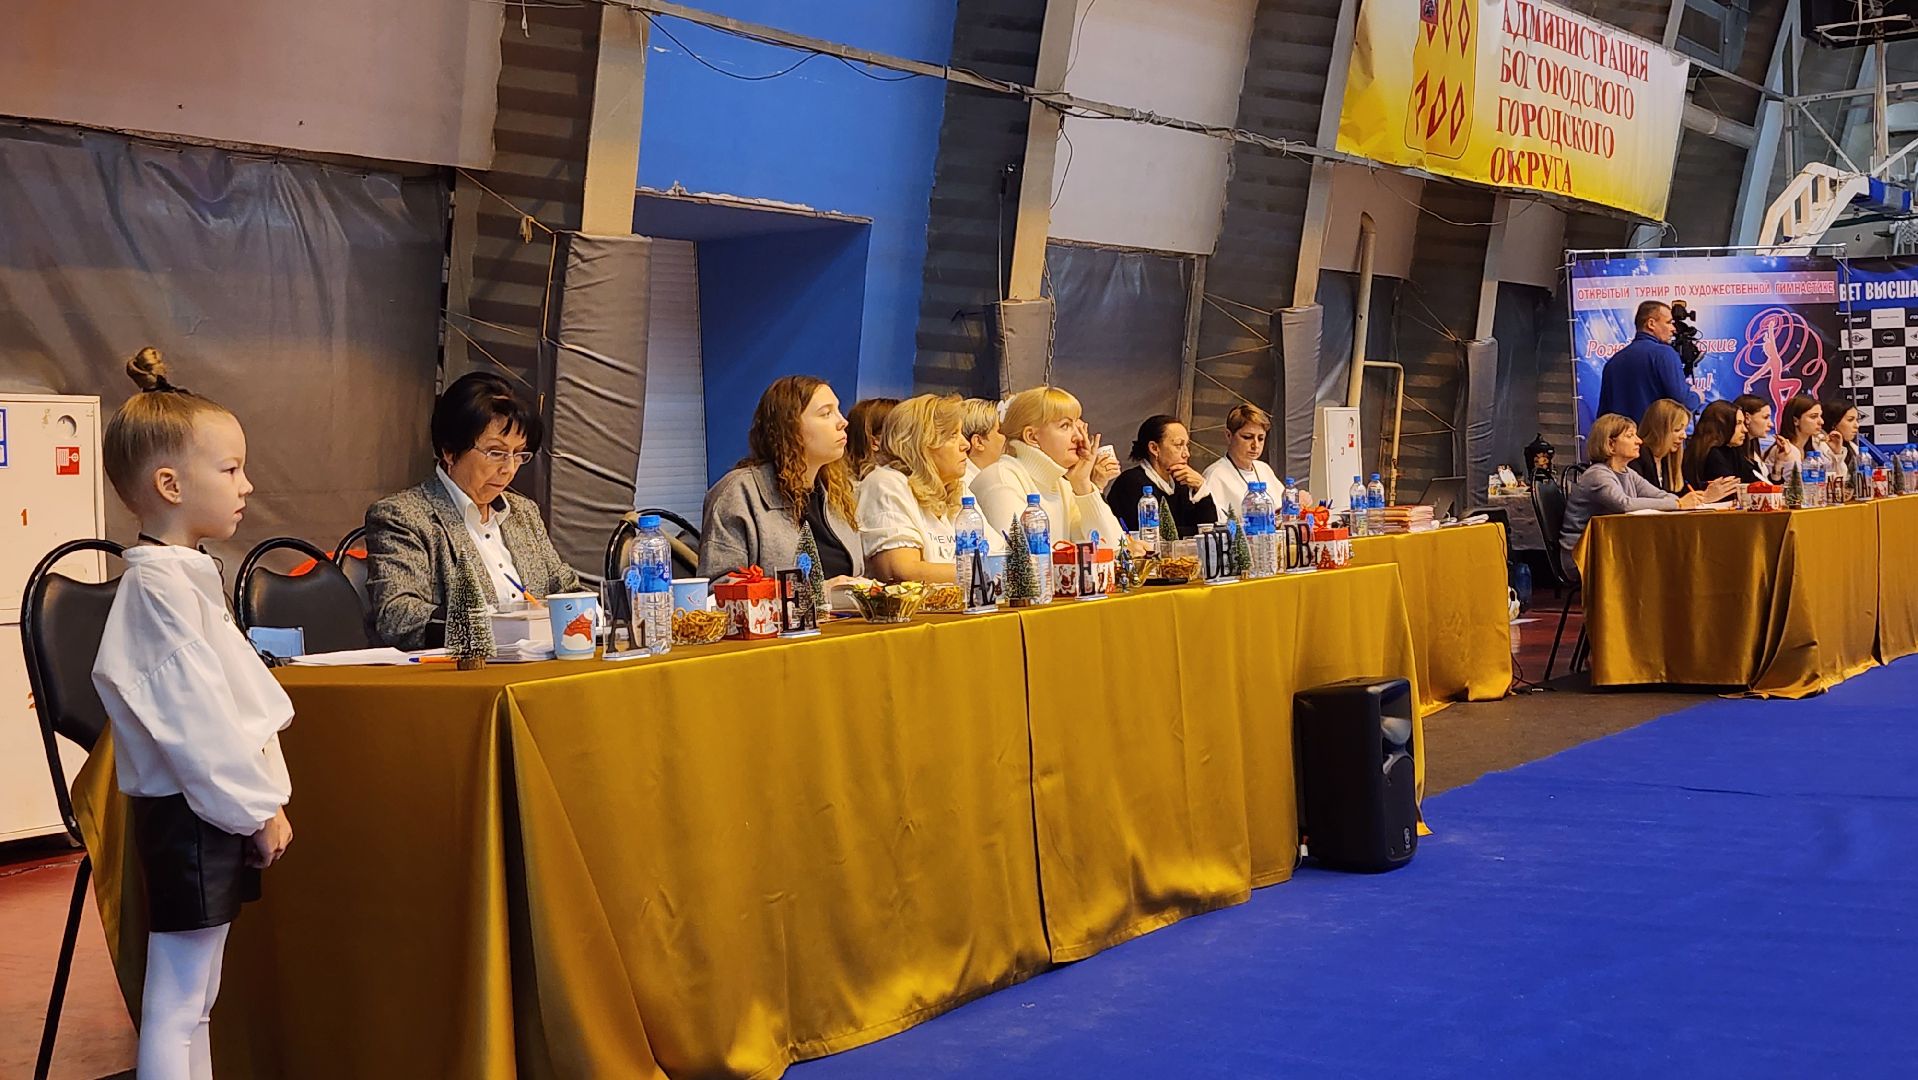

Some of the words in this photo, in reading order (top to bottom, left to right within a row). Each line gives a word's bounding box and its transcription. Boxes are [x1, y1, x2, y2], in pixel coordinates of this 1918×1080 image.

[1502, 0, 1649, 82] АДМИНИСТРАЦИЯ
[1500, 46, 1634, 120] БОГОРОДСКОГО
[1496, 96, 1614, 159] ГОРОДСКОГО
[1490, 146, 1573, 193] ОКРУГА
[1635, 286, 1670, 298] ТУРНИР
[1674, 285, 1686, 297] ПО
[1689, 281, 1770, 297] ХУДОЖЕСТВЕННОЙ
